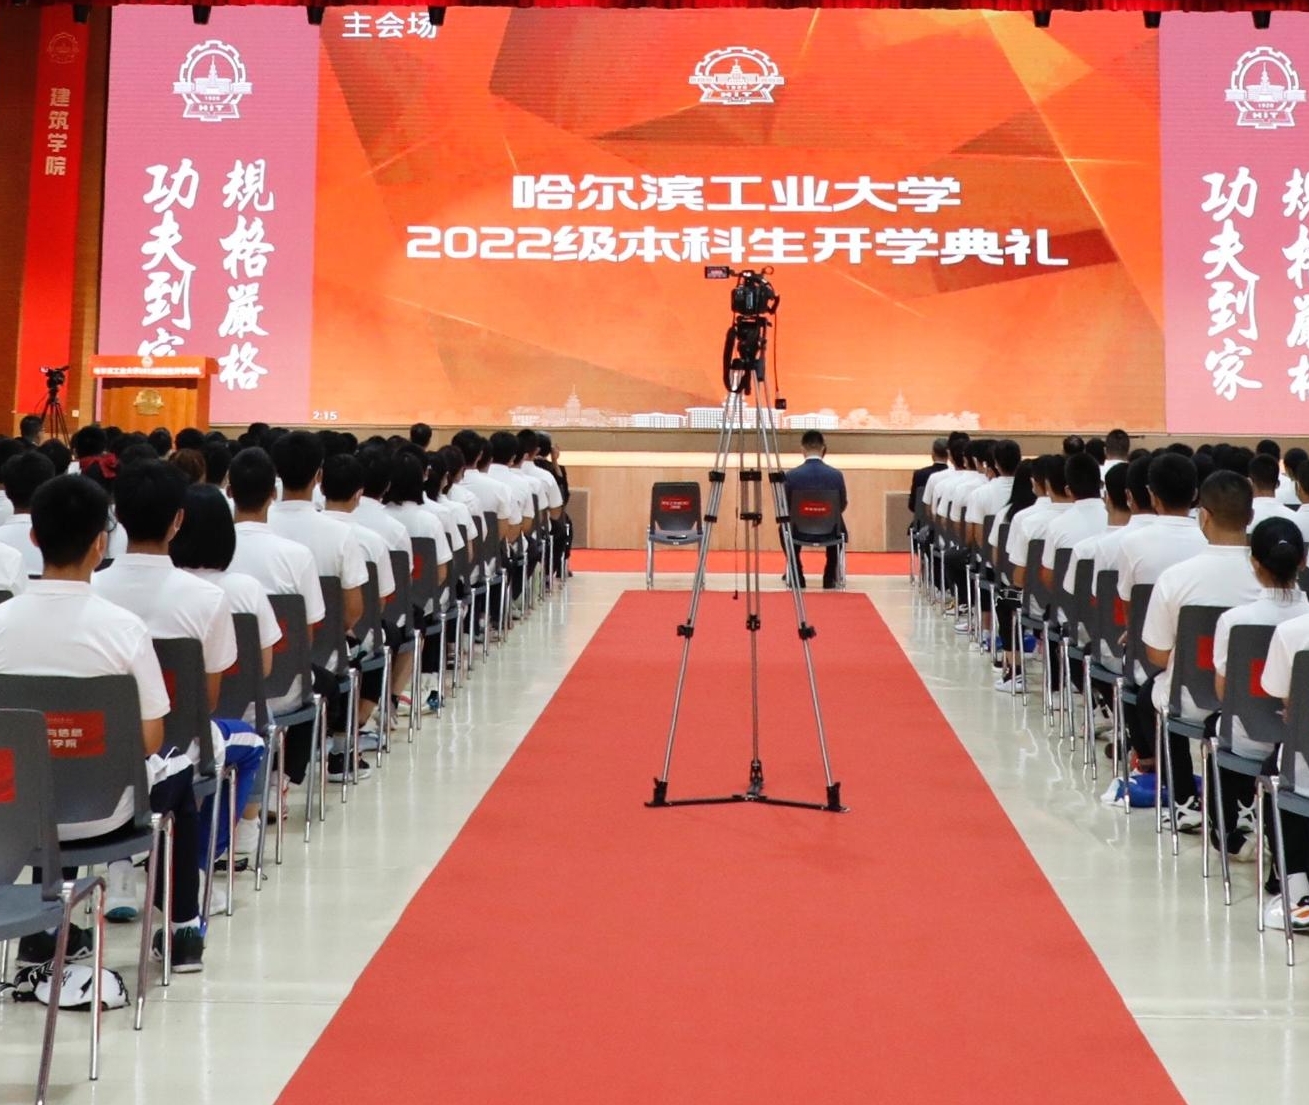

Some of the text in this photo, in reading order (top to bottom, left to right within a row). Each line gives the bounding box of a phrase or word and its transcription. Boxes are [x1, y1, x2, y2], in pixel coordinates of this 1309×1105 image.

[341, 11, 437, 38] 主会场
[45, 87, 72, 176] 建筑学院
[512, 174, 961, 213] 哈尔滨工业大学
[406, 225, 1069, 265] 2022级本科生开学典礼
[1201, 166, 1263, 402] 功夫到家
